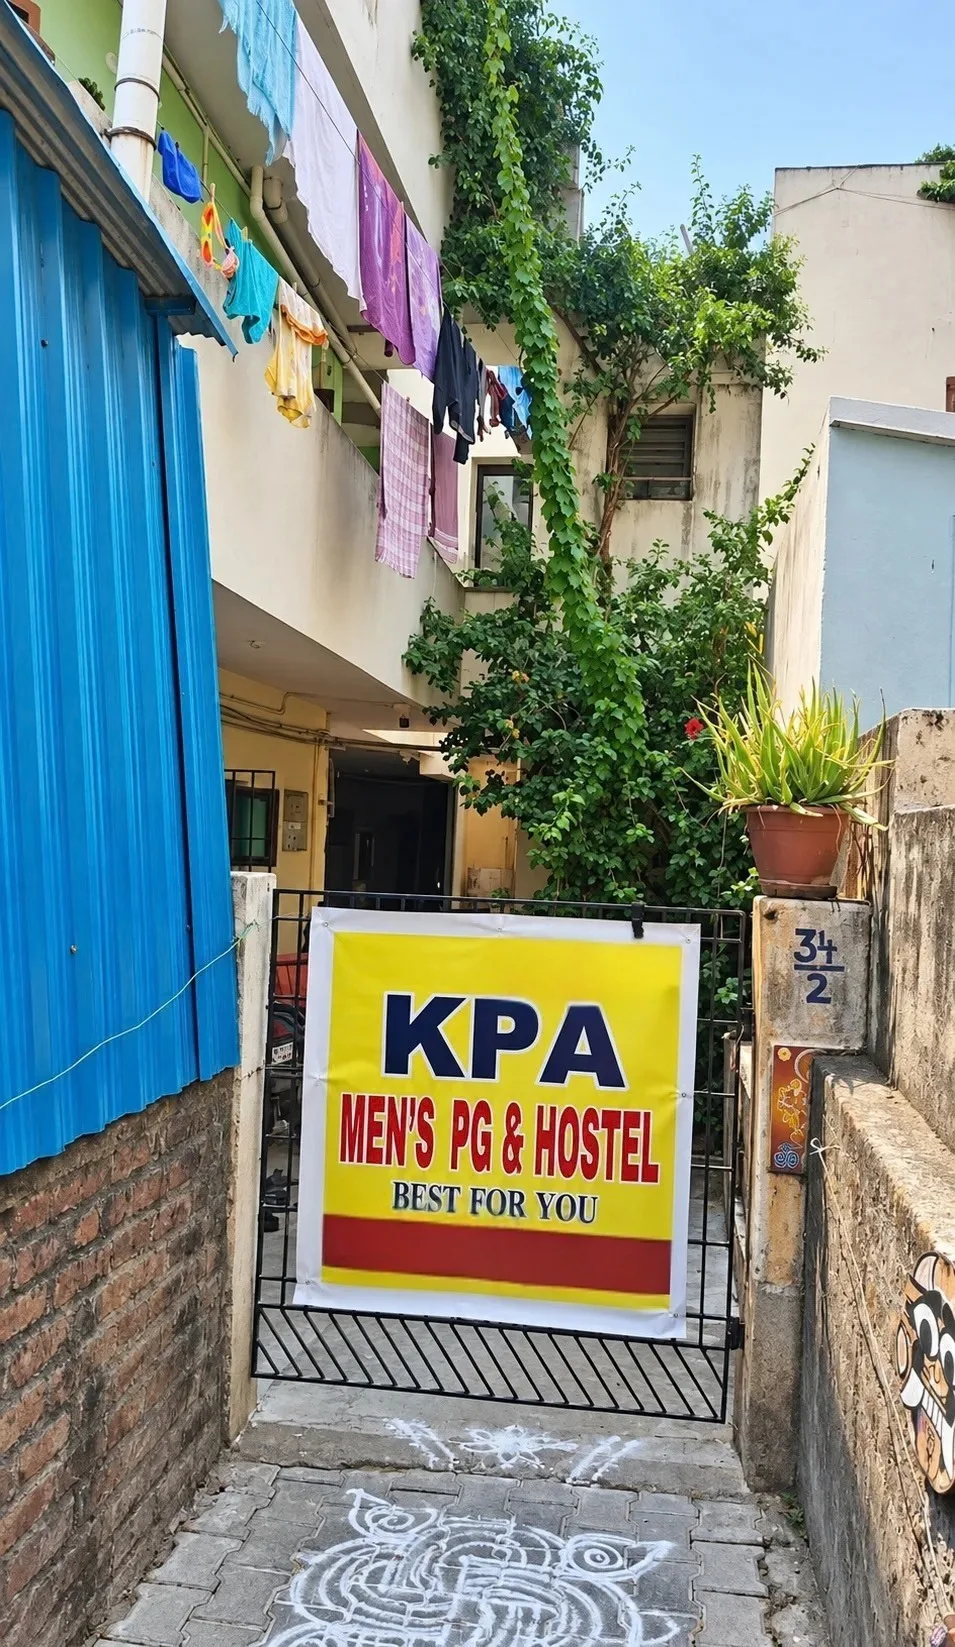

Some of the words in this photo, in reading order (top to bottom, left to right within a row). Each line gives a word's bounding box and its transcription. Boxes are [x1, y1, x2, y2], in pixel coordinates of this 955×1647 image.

[793, 928, 838, 965] 34
[806, 972, 832, 1005] 2
[382, 992, 628, 1089] KPA
[339, 1093, 436, 1169] MEN'S
[449, 1099, 494, 1173] PG
[501, 1101, 524, 1175] &
[534, 1104, 661, 1184] HOSTEL
[392, 1181, 461, 1213] BEST
[469, 1187, 527, 1218] FOR
[535, 1191, 599, 1224] YOU
